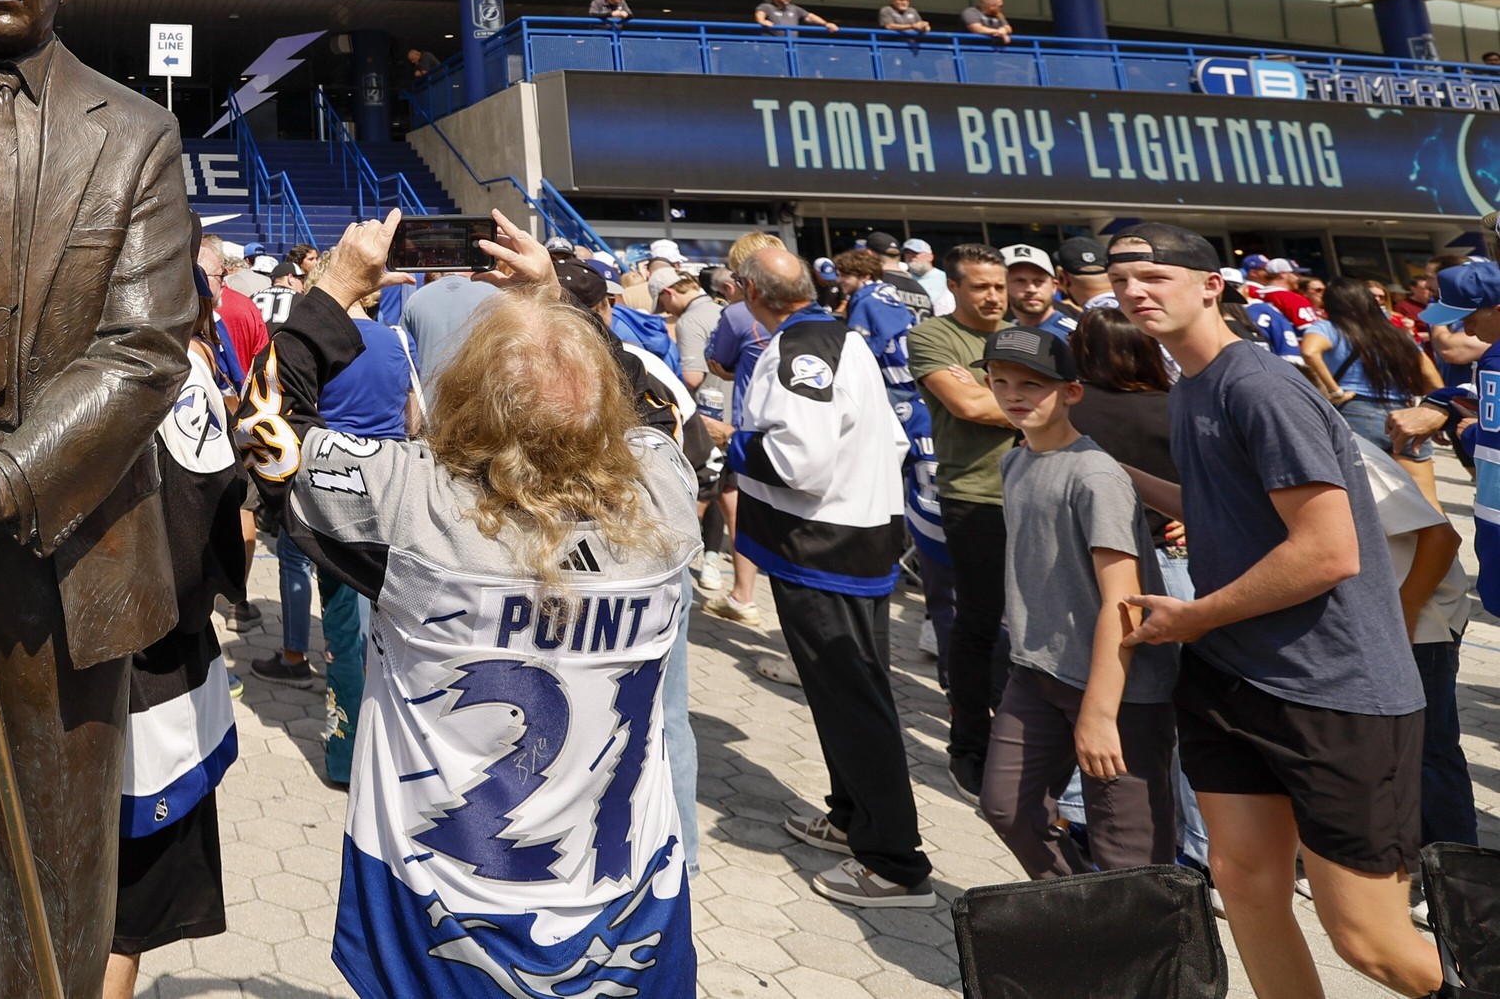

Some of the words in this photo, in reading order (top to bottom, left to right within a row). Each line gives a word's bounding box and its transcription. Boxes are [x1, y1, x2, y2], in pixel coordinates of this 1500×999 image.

[157, 41, 185, 51] LINE
[159, 32, 184, 42] BAG
[1207, 66, 1300, 99] TB
[1309, 70, 1442, 108] TAMPA
[1445, 80, 1500, 112] BA
[753, 99, 936, 173] TAMPA
[957, 105, 1056, 177] BAY
[1079, 111, 1343, 188] LIGHTNING
[251, 292, 294, 324] 91
[309, 431, 383, 497] 21
[496, 593, 651, 655] POINT
[407, 653, 667, 899] 21
